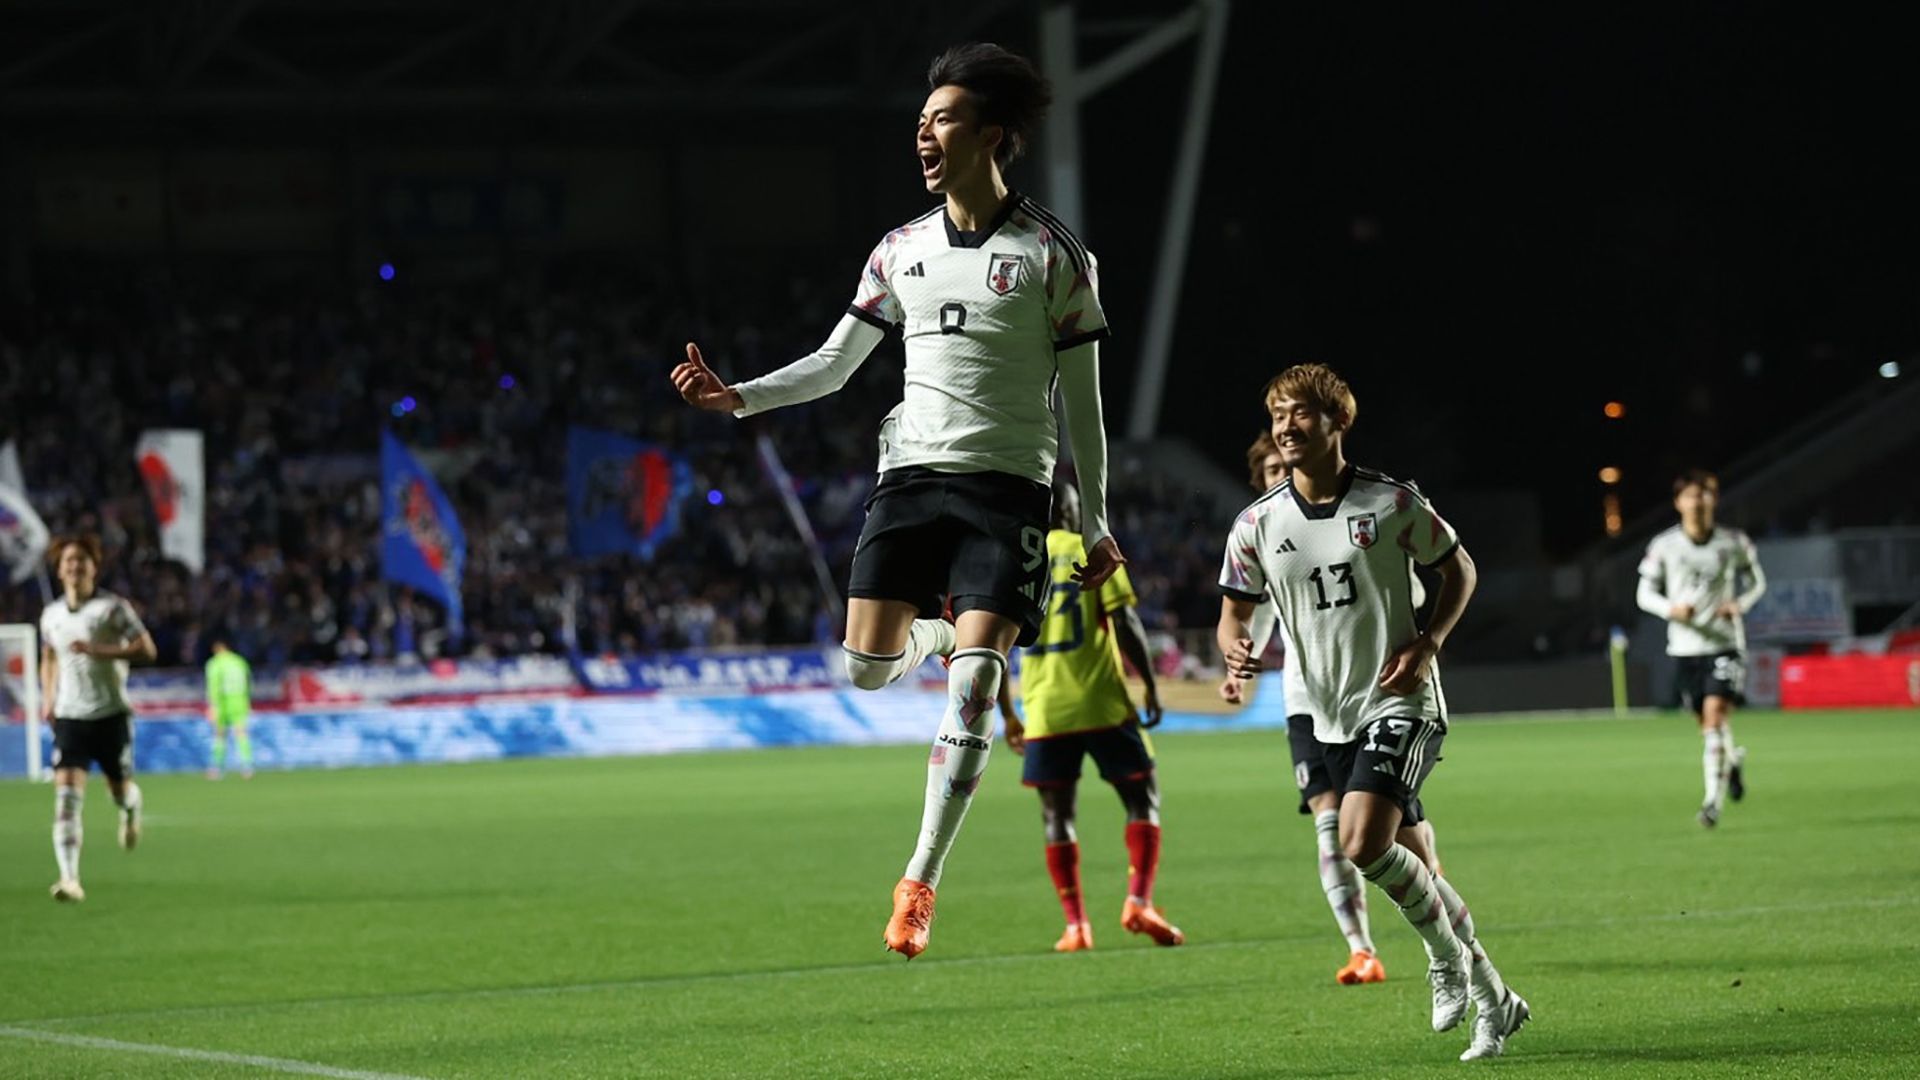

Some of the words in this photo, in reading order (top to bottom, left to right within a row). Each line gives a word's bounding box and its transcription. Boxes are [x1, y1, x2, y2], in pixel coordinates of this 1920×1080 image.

[1021, 526, 1044, 573] 9
[1308, 562, 1358, 610] 13
[1364, 719, 1413, 757] 13
